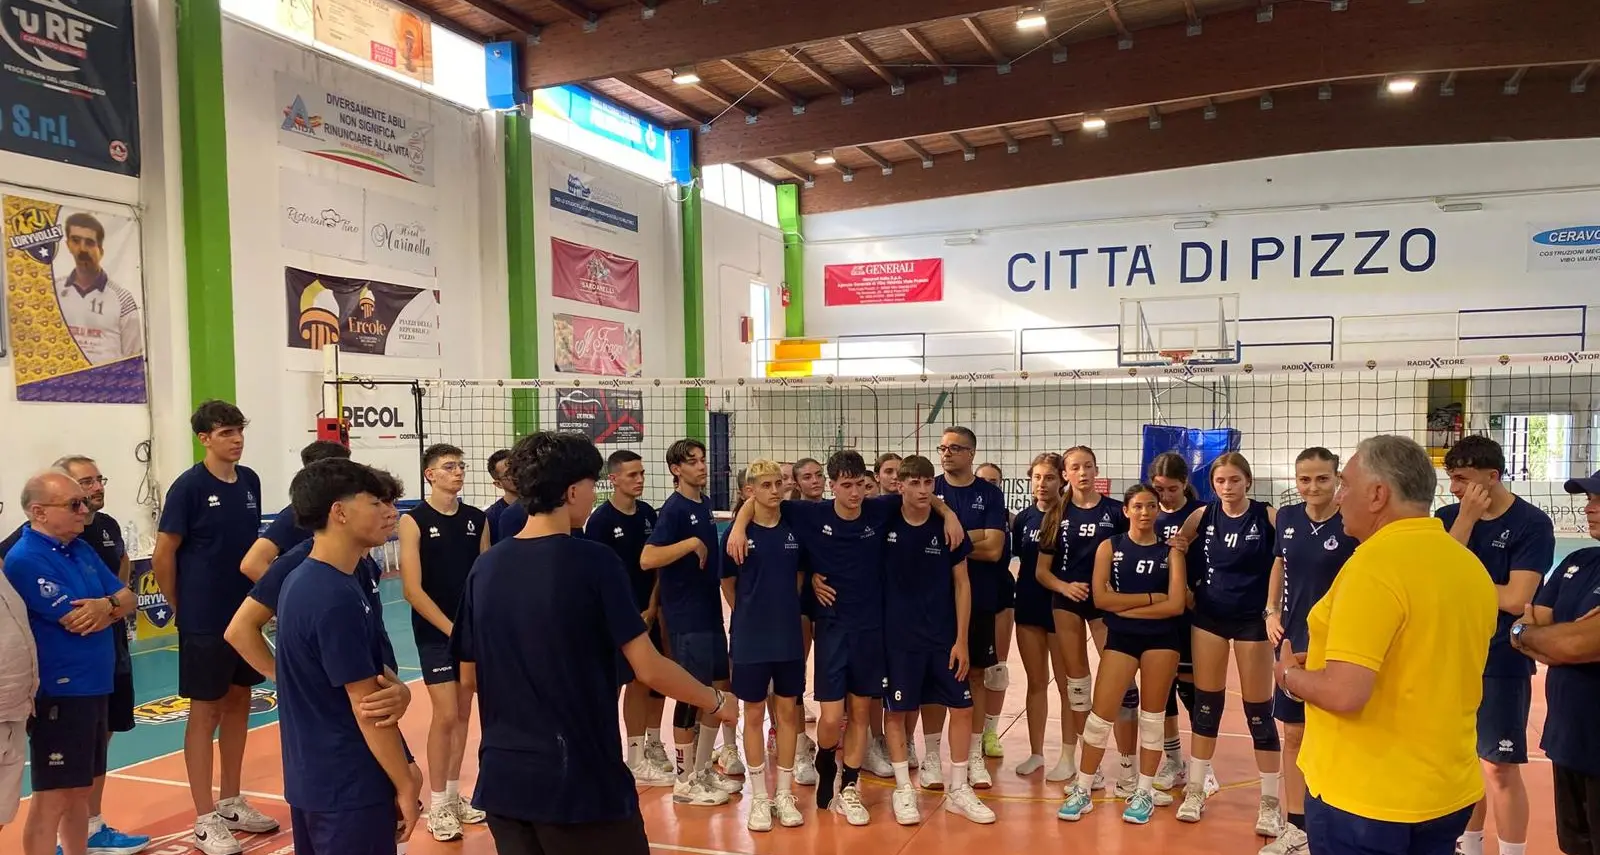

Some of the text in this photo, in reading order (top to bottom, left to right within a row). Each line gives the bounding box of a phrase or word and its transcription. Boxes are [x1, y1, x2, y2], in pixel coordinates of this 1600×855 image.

[326, 93, 406, 129] DIVERSAMENTE ABILI
[12, 104, 76, 147] S.r.l.
[340, 113, 395, 139] NON SIGNIFICA
[324, 123, 372, 147] RINUNCIARE
[374, 138, 392, 153] ALLA
[393, 146, 410, 158] VITA
[10, 225, 63, 248] LORYVOLLEY
[1179, 240, 1228, 283] DI
[1251, 228, 1437, 279] PIZZO
[866, 262, 914, 275] GENERALI
[348, 317, 387, 336] Ercole
[1079, 524, 1096, 537] 59
[1224, 533, 1238, 548] 41
[1136, 560, 1154, 574] 67
[895, 691, 902, 701] 6
[675, 748, 685, 775] FILA
